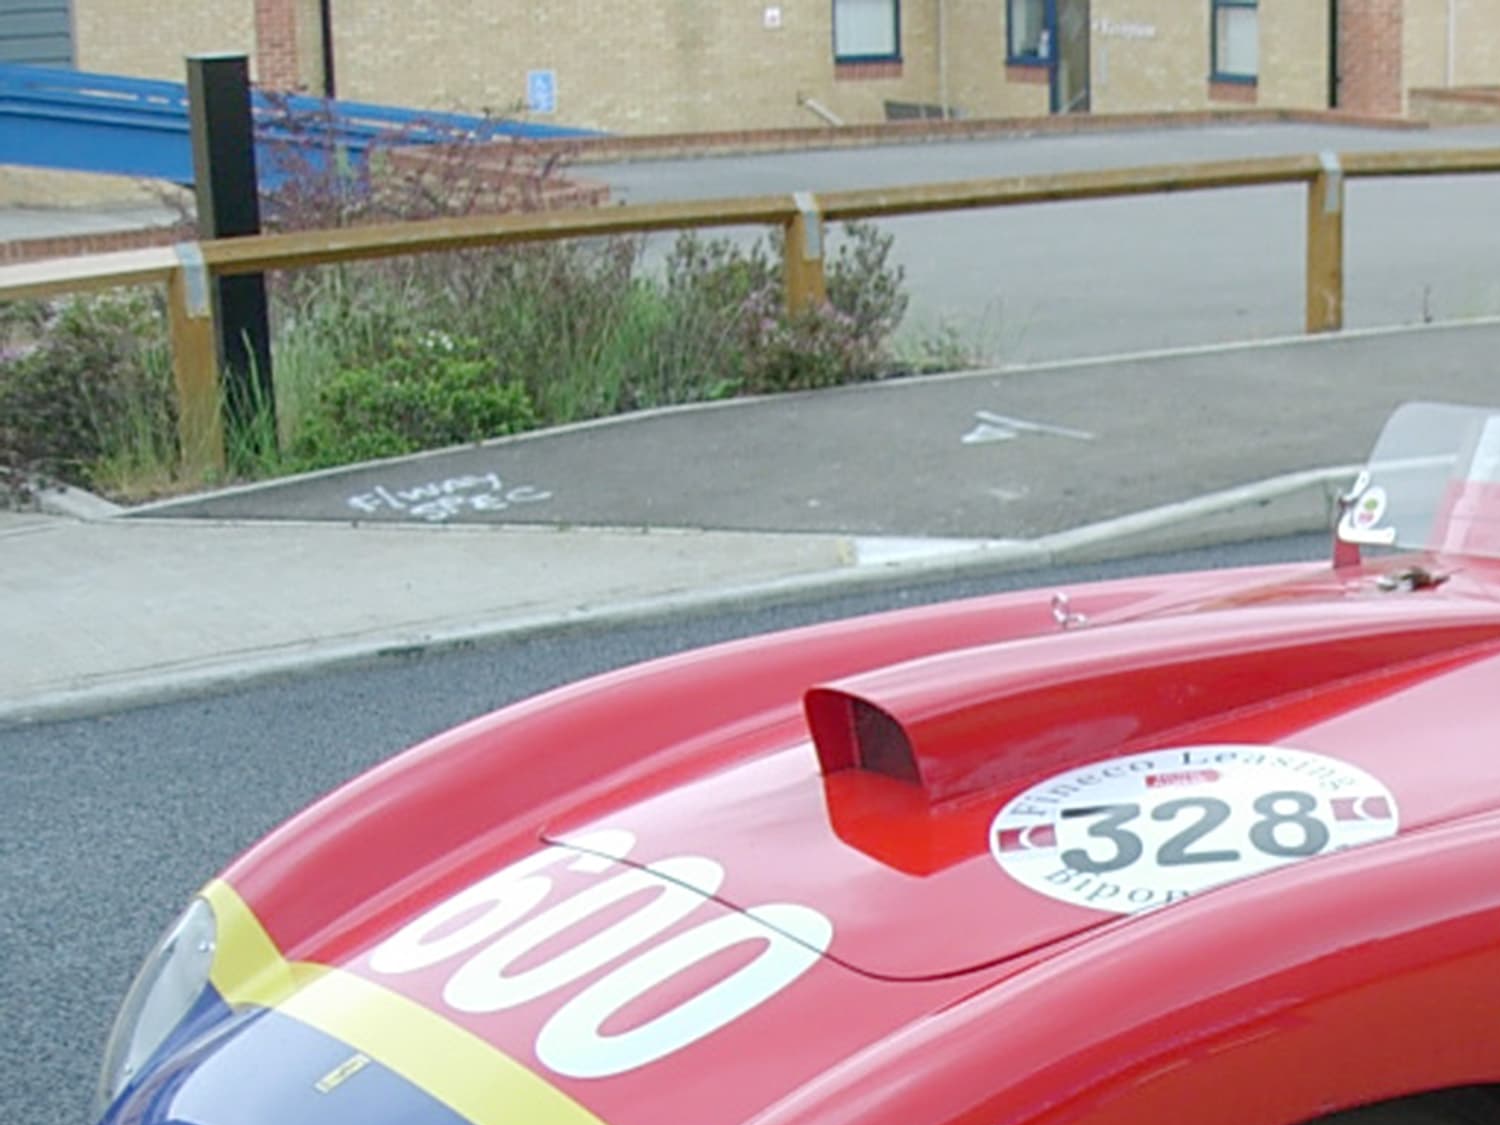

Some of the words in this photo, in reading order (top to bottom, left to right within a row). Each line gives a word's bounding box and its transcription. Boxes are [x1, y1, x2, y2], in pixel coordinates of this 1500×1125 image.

[1010, 759, 1155, 817] Fineco
[1181, 751, 1356, 790] Leasing
[1060, 790, 1330, 874] 328
[368, 828, 834, 1079] 600
